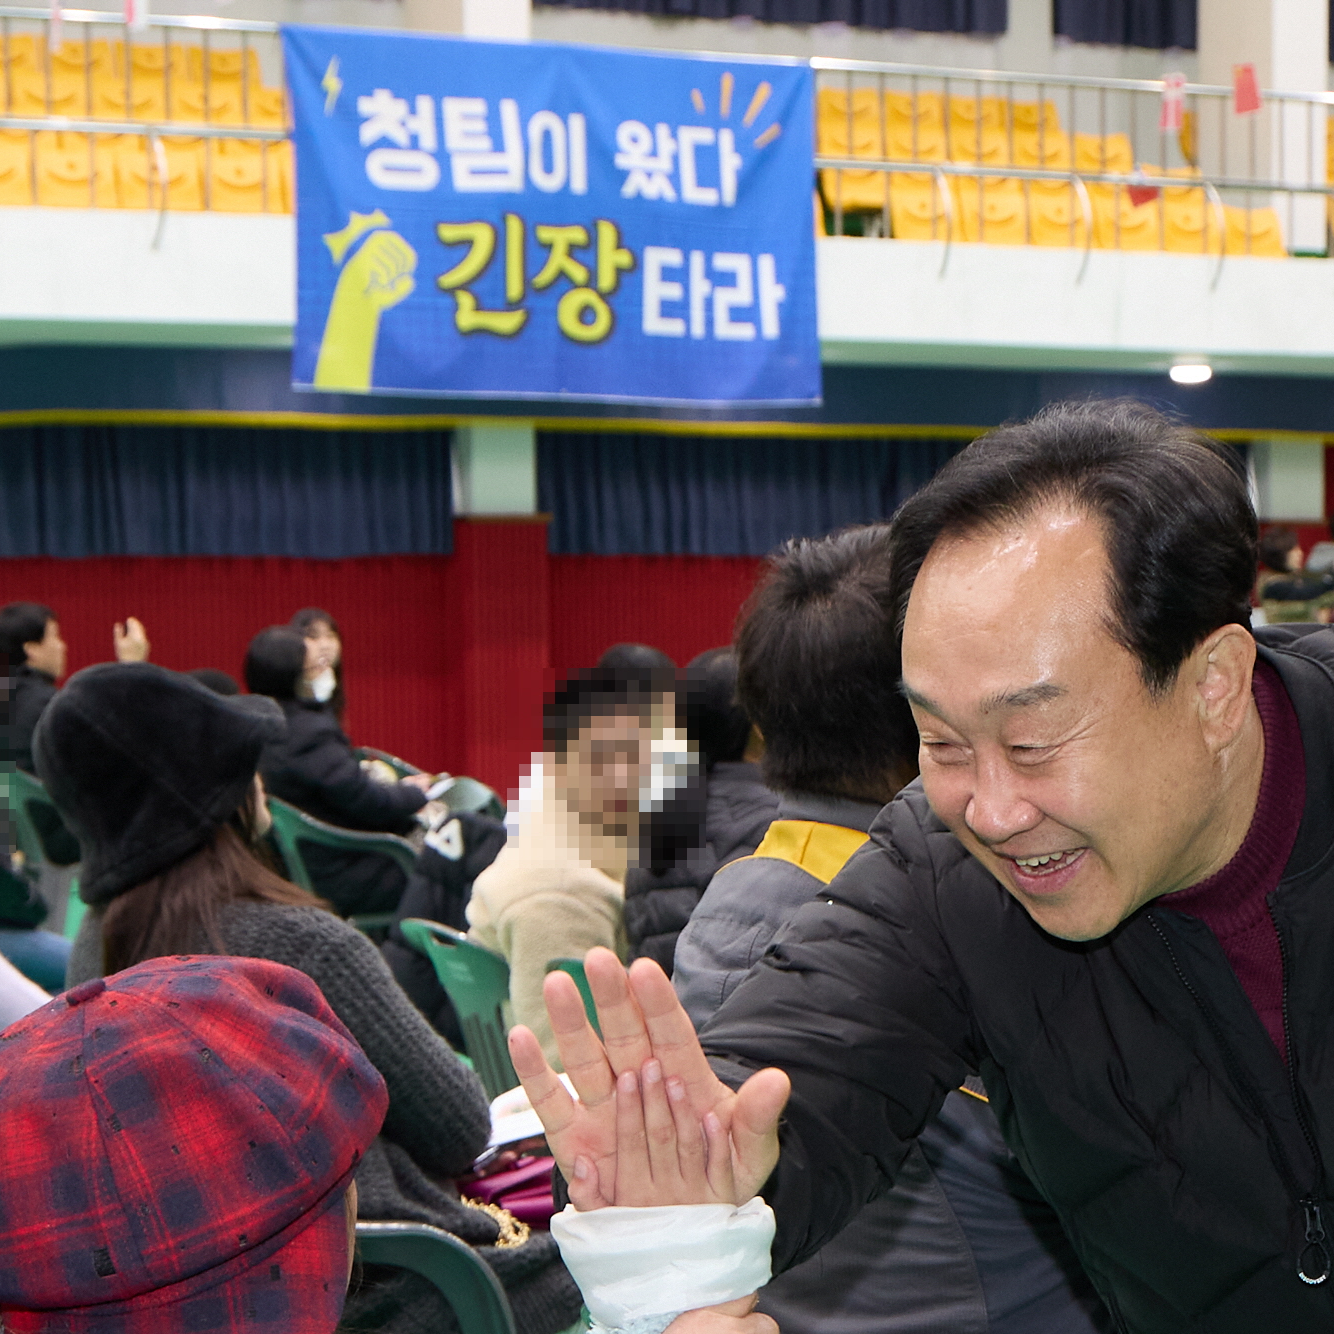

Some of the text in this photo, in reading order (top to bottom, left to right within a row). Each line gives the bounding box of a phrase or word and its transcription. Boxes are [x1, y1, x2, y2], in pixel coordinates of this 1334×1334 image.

[357, 88, 743, 208] 청팀이 왔다
[435, 212, 786, 345] 긴장 타라
